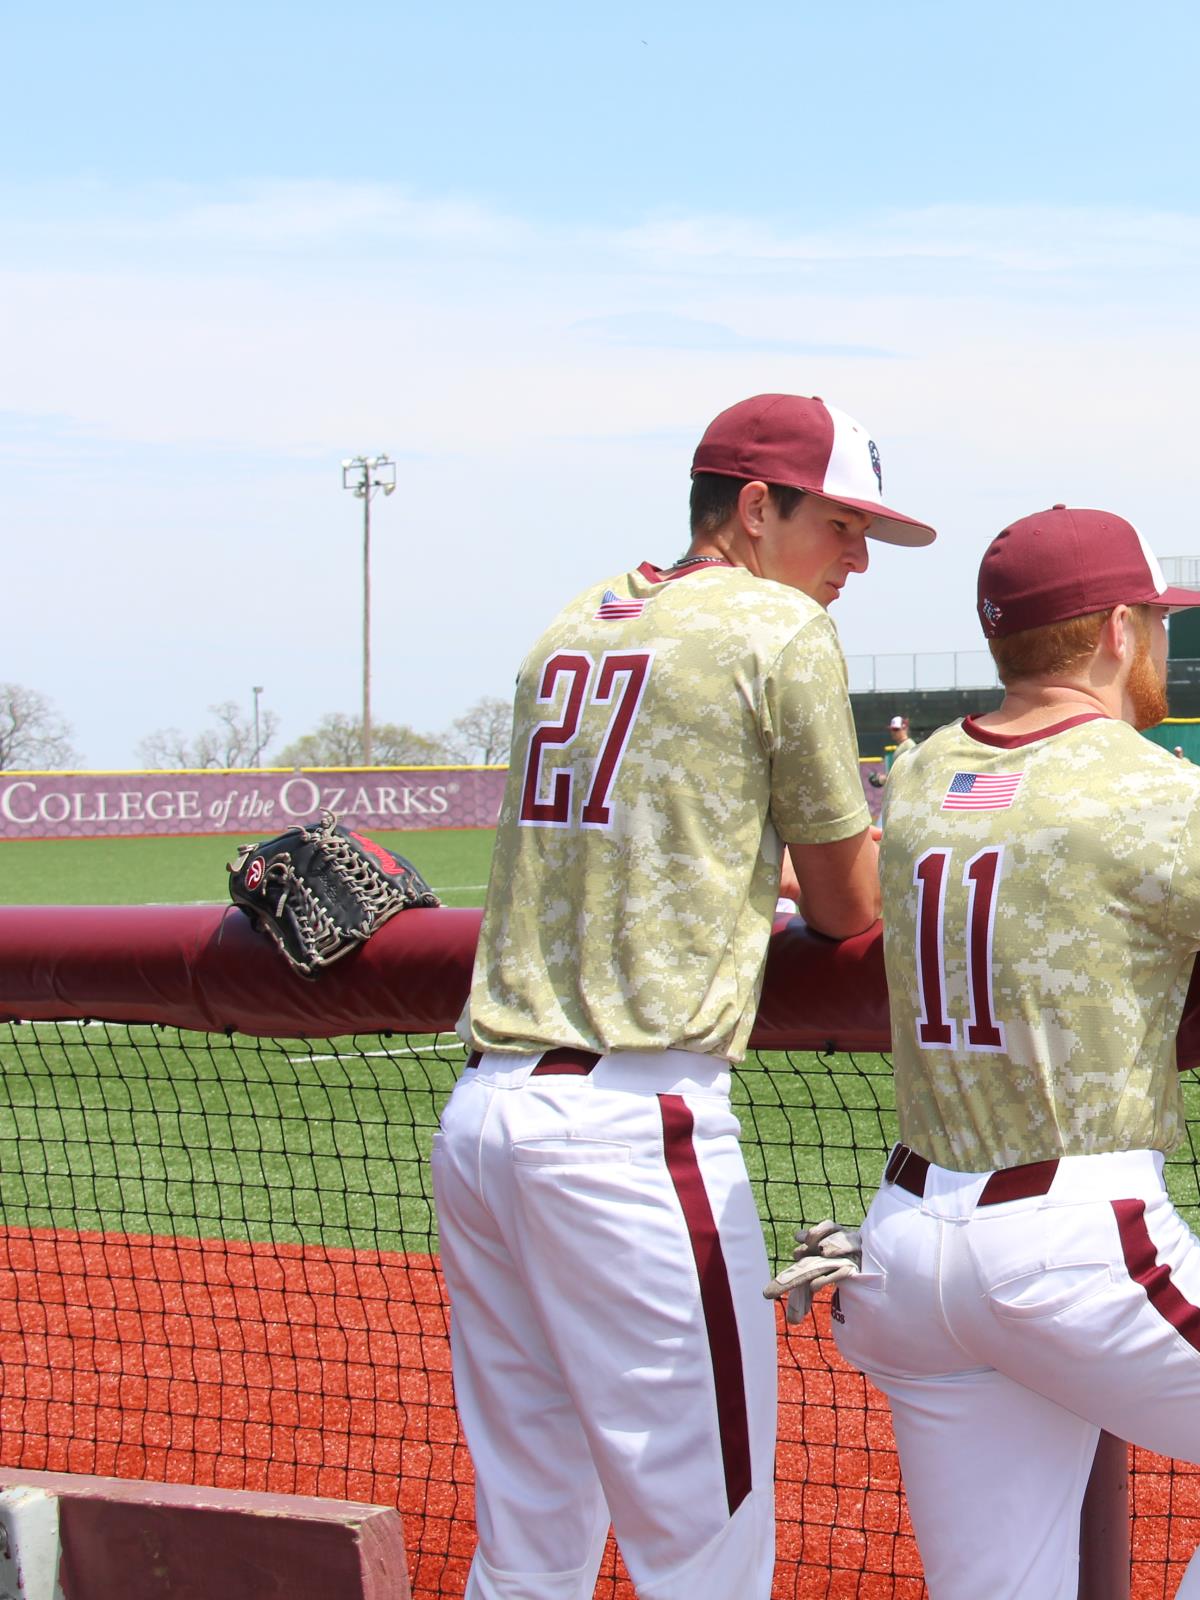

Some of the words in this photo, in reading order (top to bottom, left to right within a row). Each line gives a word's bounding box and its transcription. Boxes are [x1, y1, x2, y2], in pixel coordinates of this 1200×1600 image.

[1, 781, 201, 824] COLLEGE
[209, 790, 239, 828] of
[239, 790, 275, 818] the
[518, 648, 655, 829] 27
[912, 845, 1006, 1053] 11
